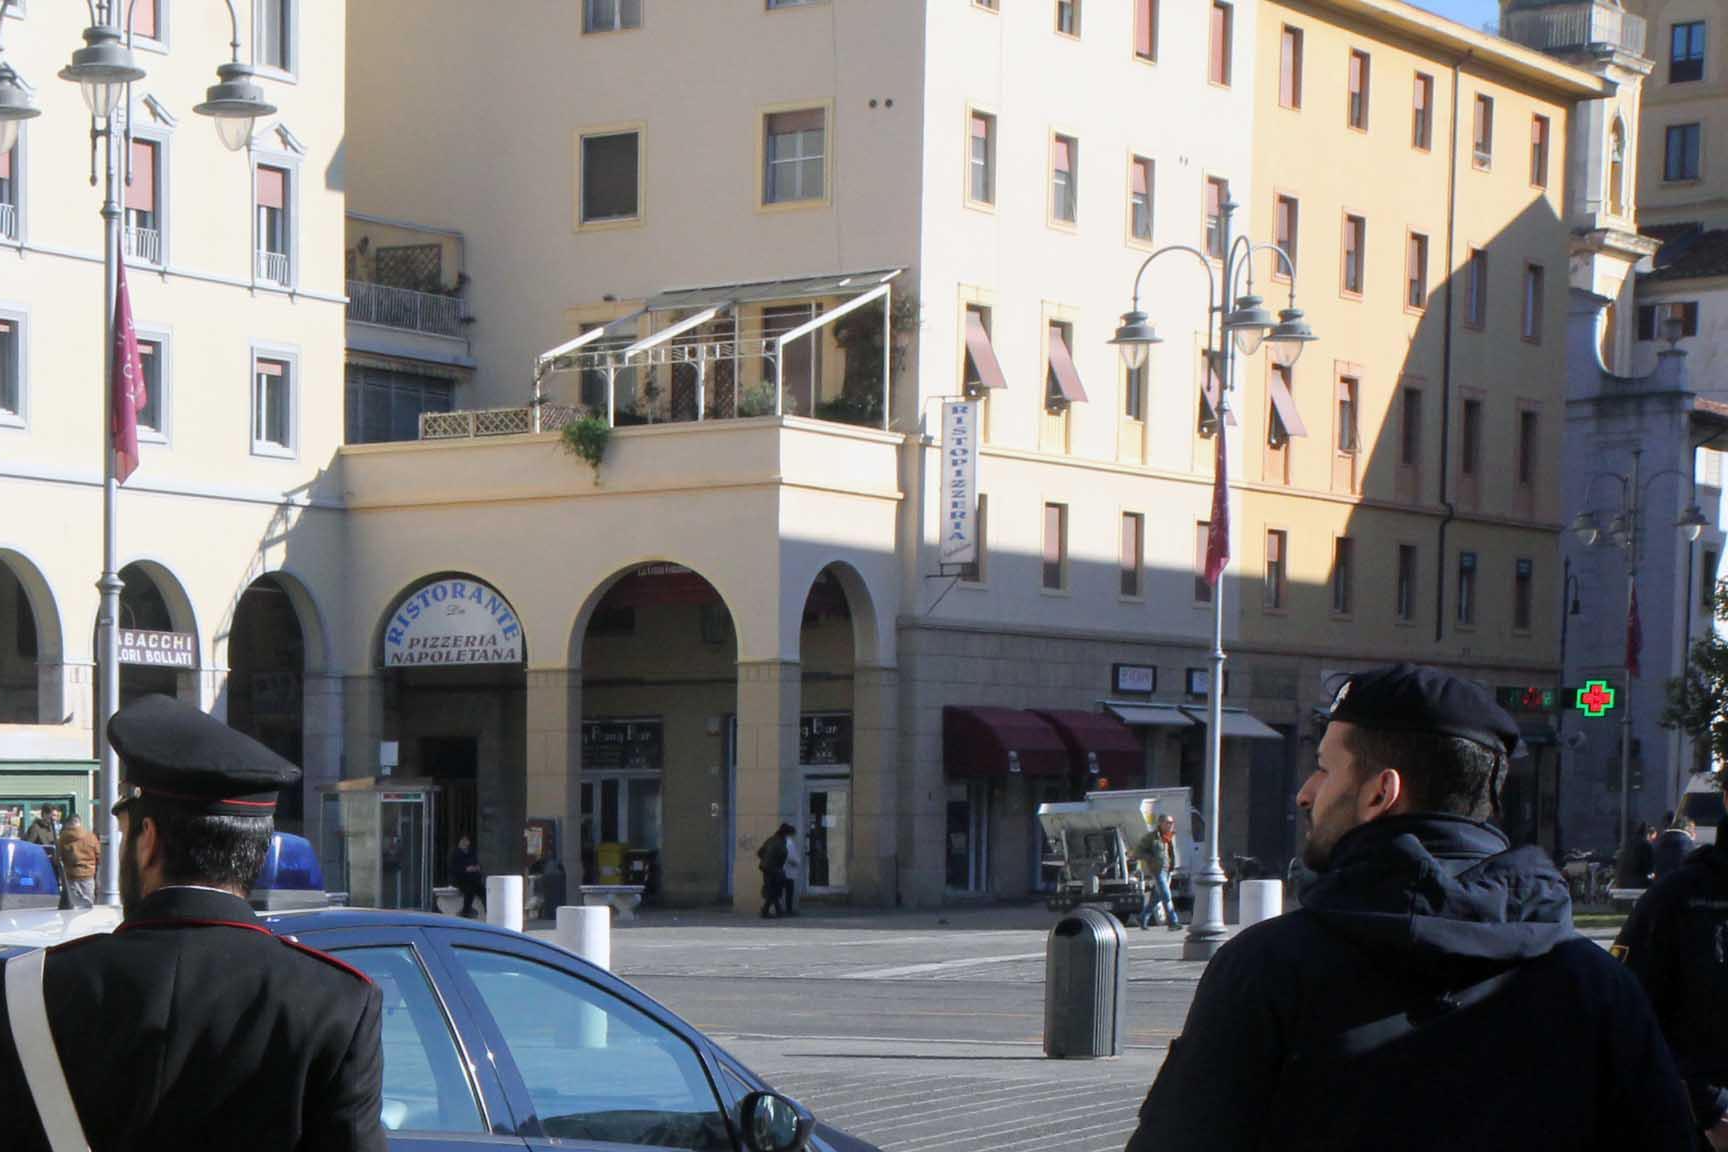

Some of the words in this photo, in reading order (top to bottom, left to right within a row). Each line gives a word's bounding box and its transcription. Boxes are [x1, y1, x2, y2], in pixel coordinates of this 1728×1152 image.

[948, 405, 969, 541] RISTOPIZZERIA
[387, 581, 520, 647] RISTORANTE
[408, 633, 498, 650] PIZZERIA
[145, 649, 192, 665] BOLLATI
[391, 648, 516, 665] NAPOLETANA
